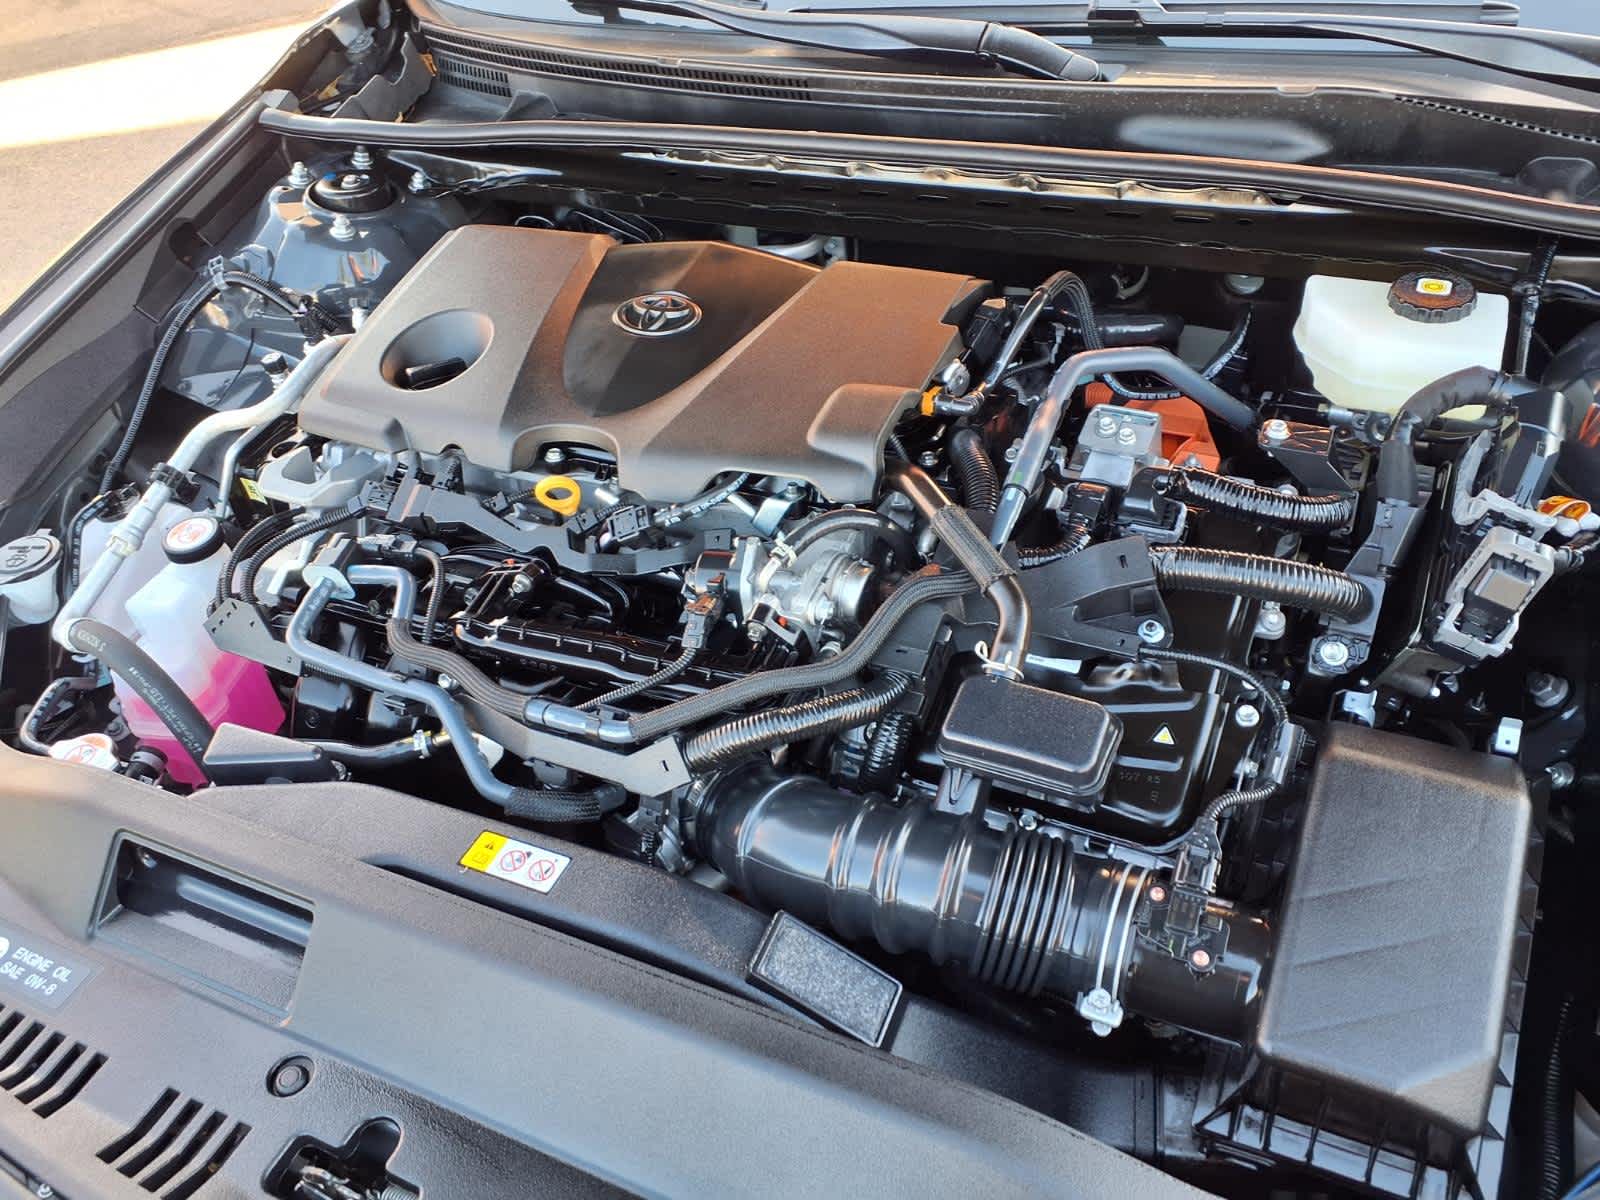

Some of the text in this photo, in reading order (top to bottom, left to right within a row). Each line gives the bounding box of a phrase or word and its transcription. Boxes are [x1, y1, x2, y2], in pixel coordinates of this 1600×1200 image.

[0, 961, 25, 979] SAE
[13, 947, 72, 982] ENGINE OIL
